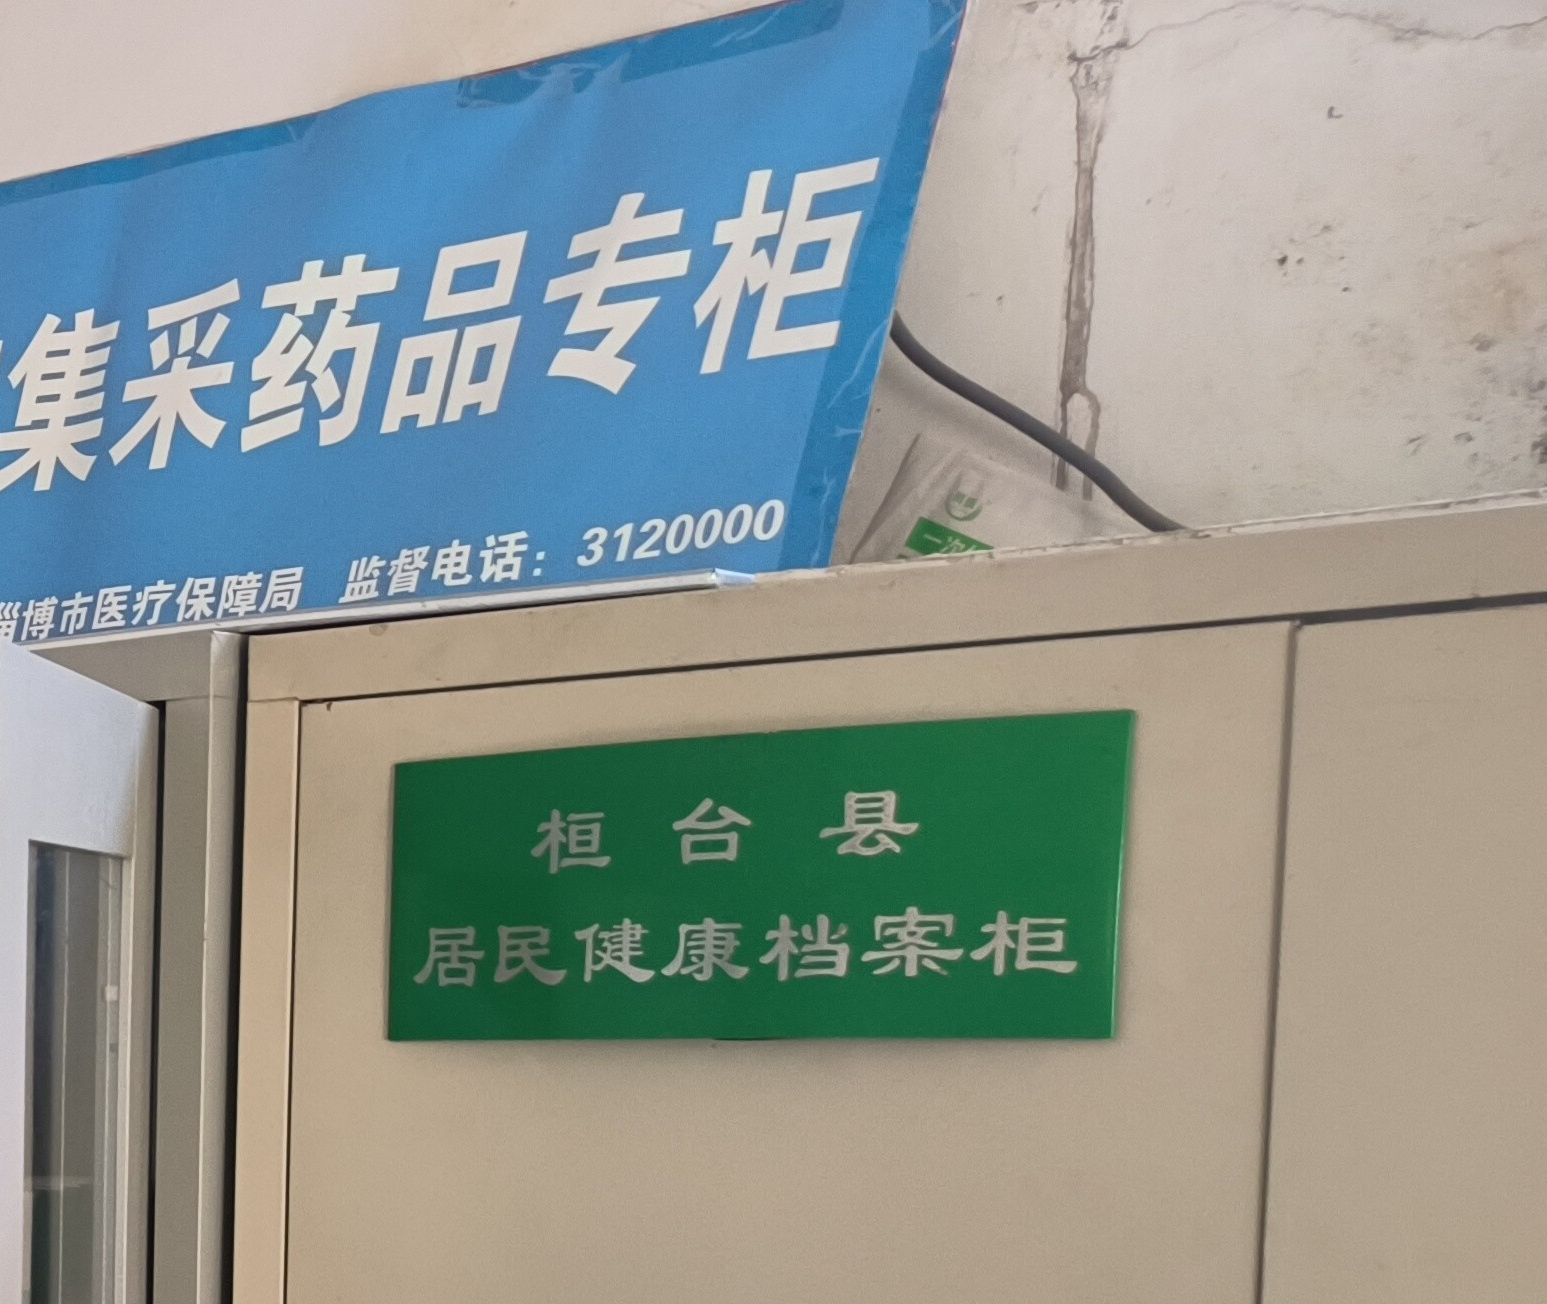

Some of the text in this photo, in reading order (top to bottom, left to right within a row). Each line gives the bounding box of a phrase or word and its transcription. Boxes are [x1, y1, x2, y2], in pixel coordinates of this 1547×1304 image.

[530, 790, 921, 875] 桓台县
[413, 906, 1079, 988] 居民健康档案柜
